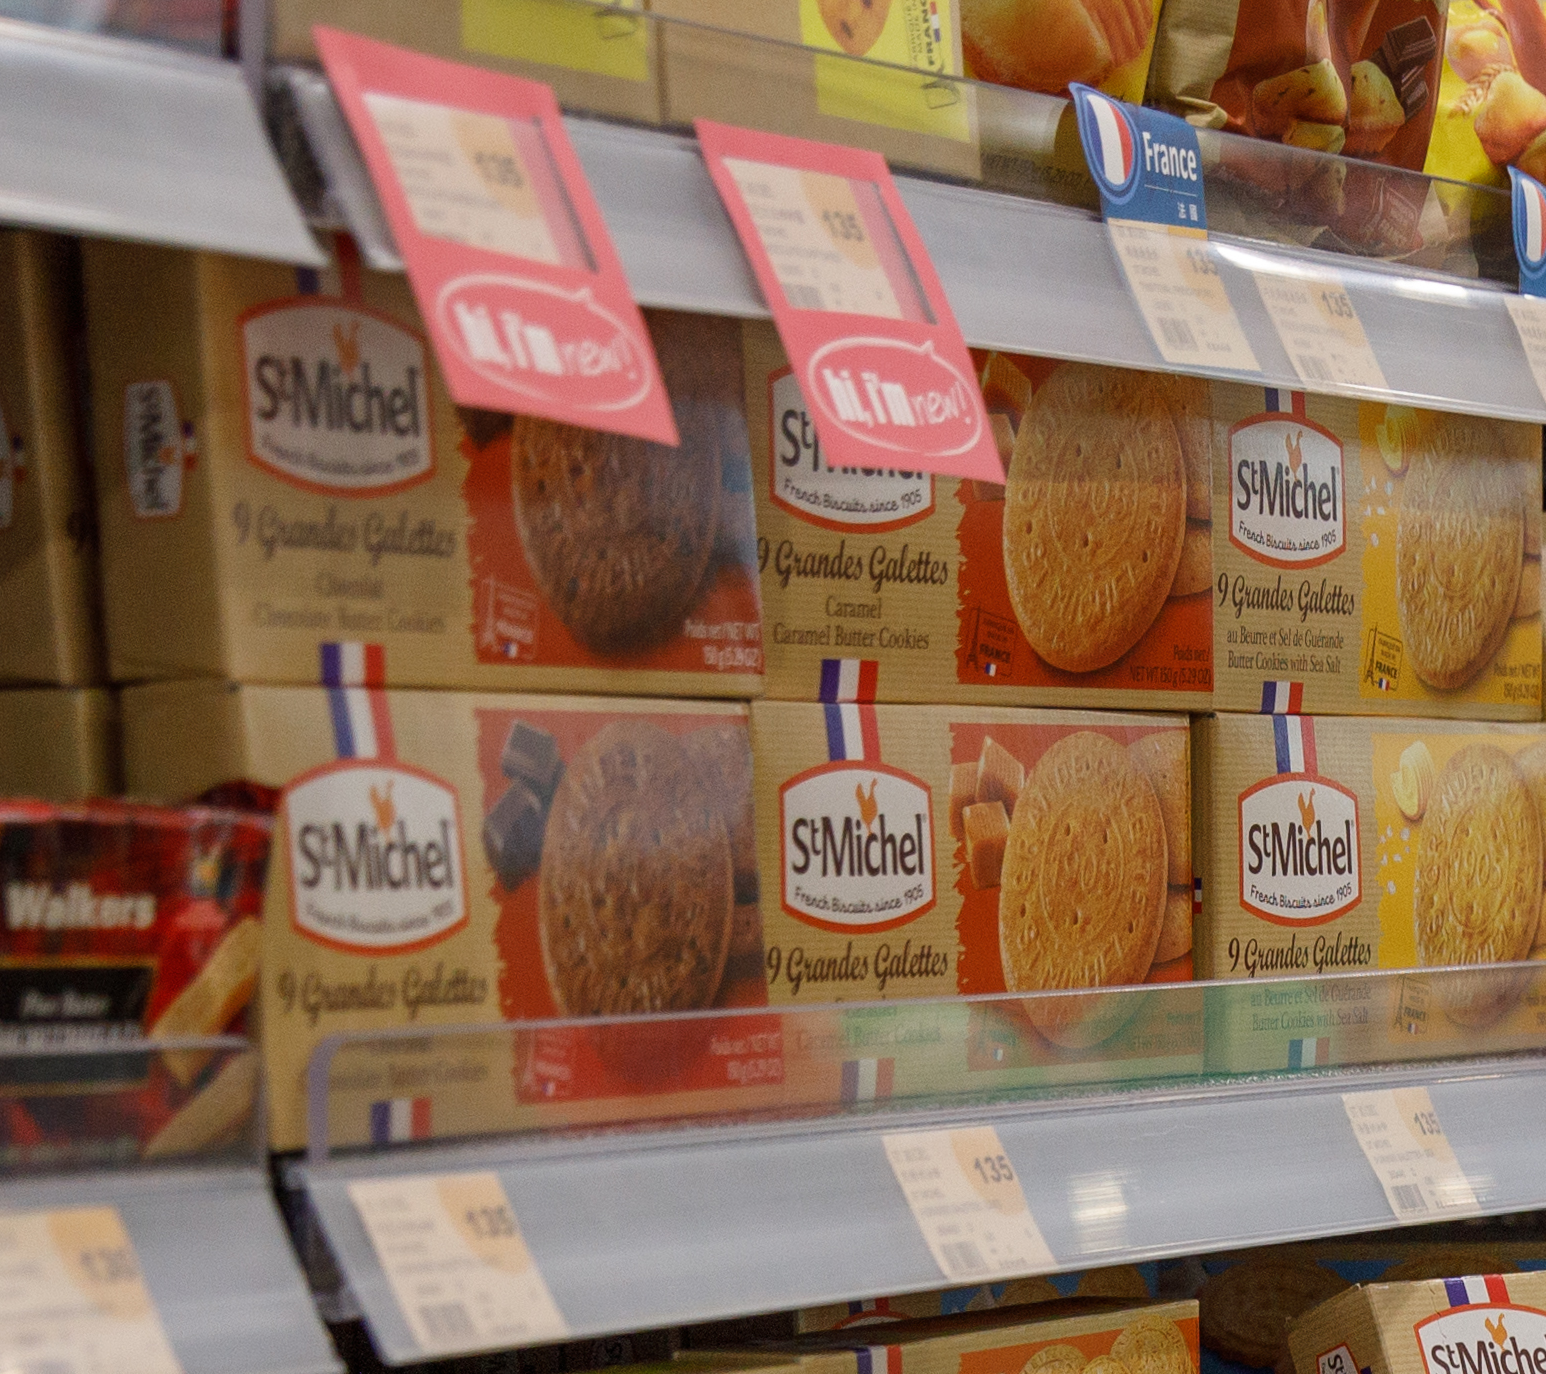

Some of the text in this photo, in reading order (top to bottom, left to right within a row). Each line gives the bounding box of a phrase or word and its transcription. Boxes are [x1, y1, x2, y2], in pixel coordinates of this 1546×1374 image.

[1143, 131, 1197, 181] France
[775, 539, 862, 587] Grandes
[869, 544, 948, 593] Galettes
[6, 884, 154, 928] Walkers
[767, 939, 948, 996] 9 Grandes Galettes
[1228, 931, 1372, 976] 9 Grandes Galettes
[1413, 1111, 1444, 1137] 135
[972, 1155, 1014, 1187] 135
